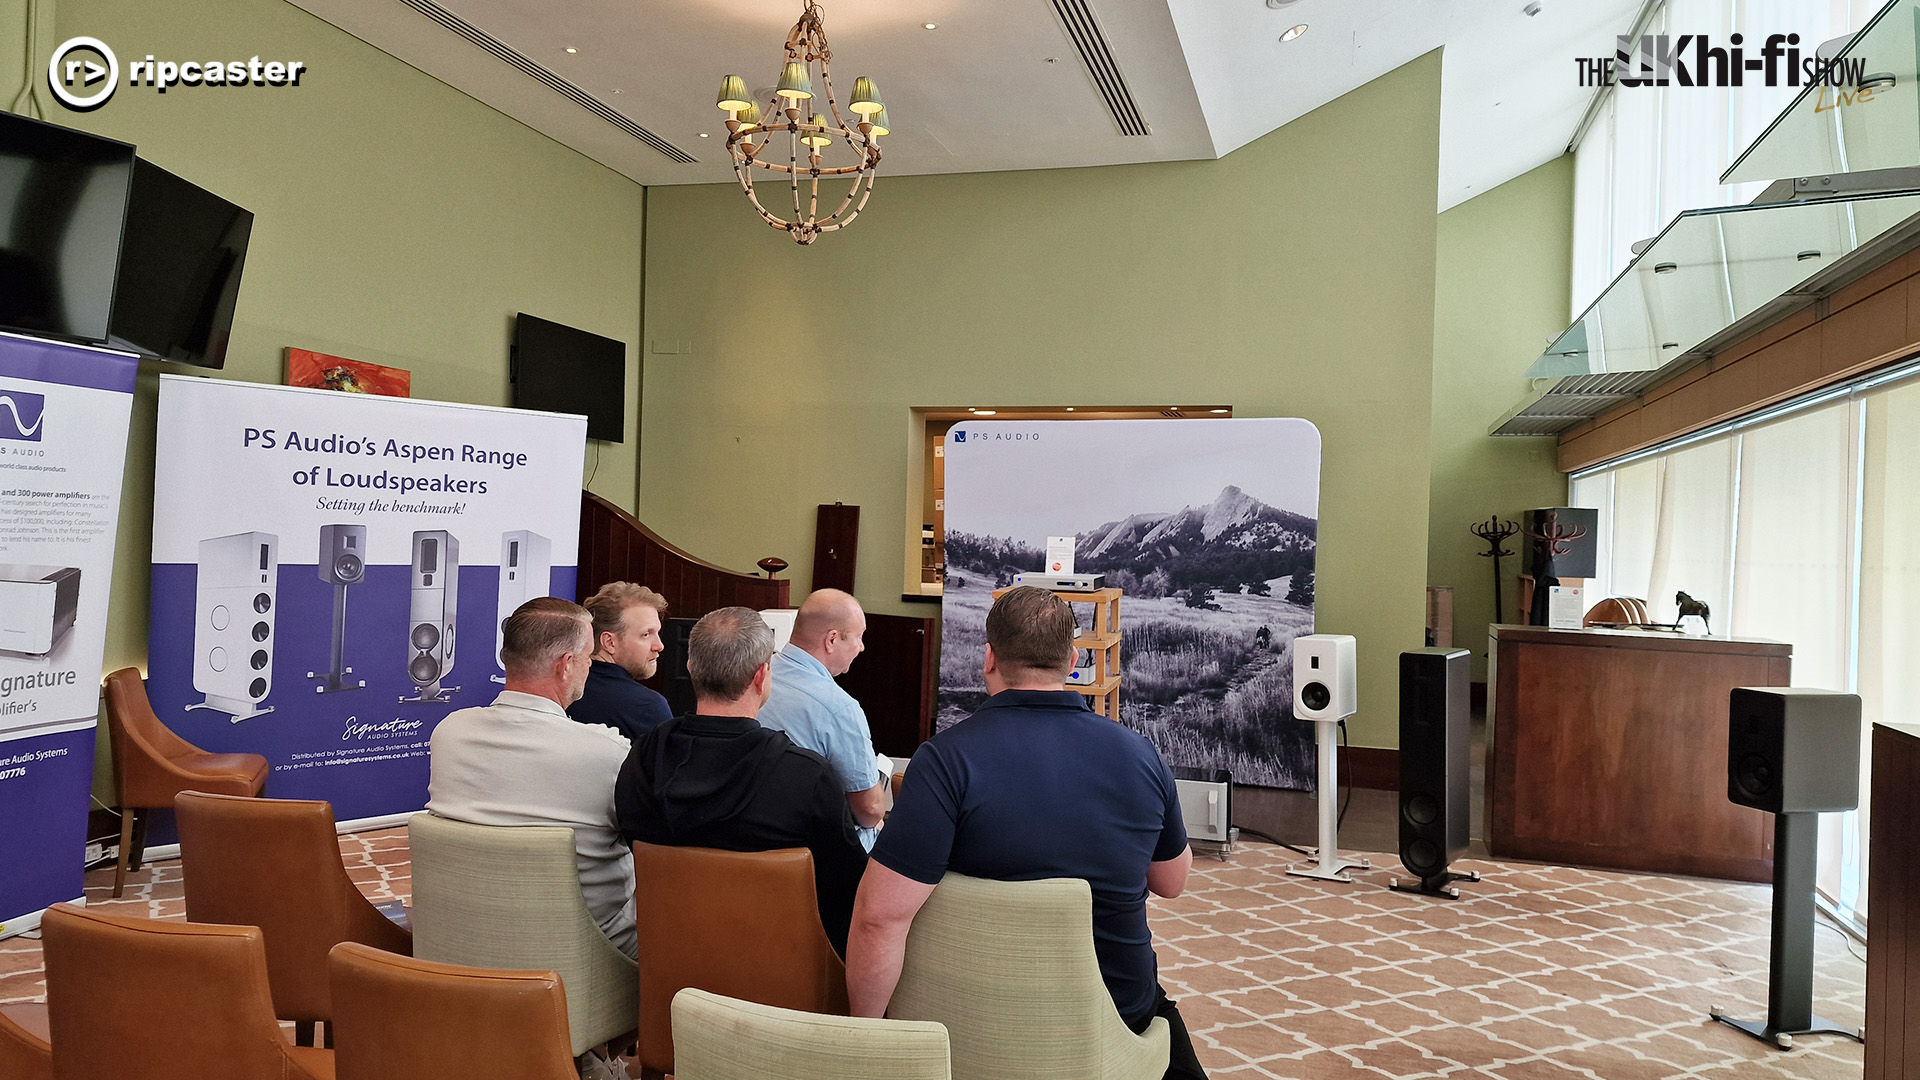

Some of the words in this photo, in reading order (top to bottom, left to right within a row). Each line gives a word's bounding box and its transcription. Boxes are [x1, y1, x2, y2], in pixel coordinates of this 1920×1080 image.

[996, 433, 1040, 441] AUDIO
[12, 448, 45, 457] AUDIO
[244, 428, 277, 449] PS
[284, 431, 376, 456] Audio's
[383, 439, 454, 463] Aspen
[461, 444, 528, 470] Range
[292, 466, 320, 486] of
[326, 468, 488, 494] Loudspeakers
[17, 489, 30, 497] 300
[31, 490, 54, 499] power
[54, 491, 91, 500] amplifiers
[316, 496, 365, 515] Setting
[369, 498, 389, 513] the
[391, 500, 466, 515] benchmark!
[342, 716, 423, 740] Signature
[391, 730, 418, 738] SYSTEMS
[11, 754, 35, 765] Audio
[36, 748, 68, 762] Systems
[291, 751, 326, 761] Distributed
[336, 748, 365, 757] Signature
[324, 751, 409, 767] info@signaturesystems.co.uk
